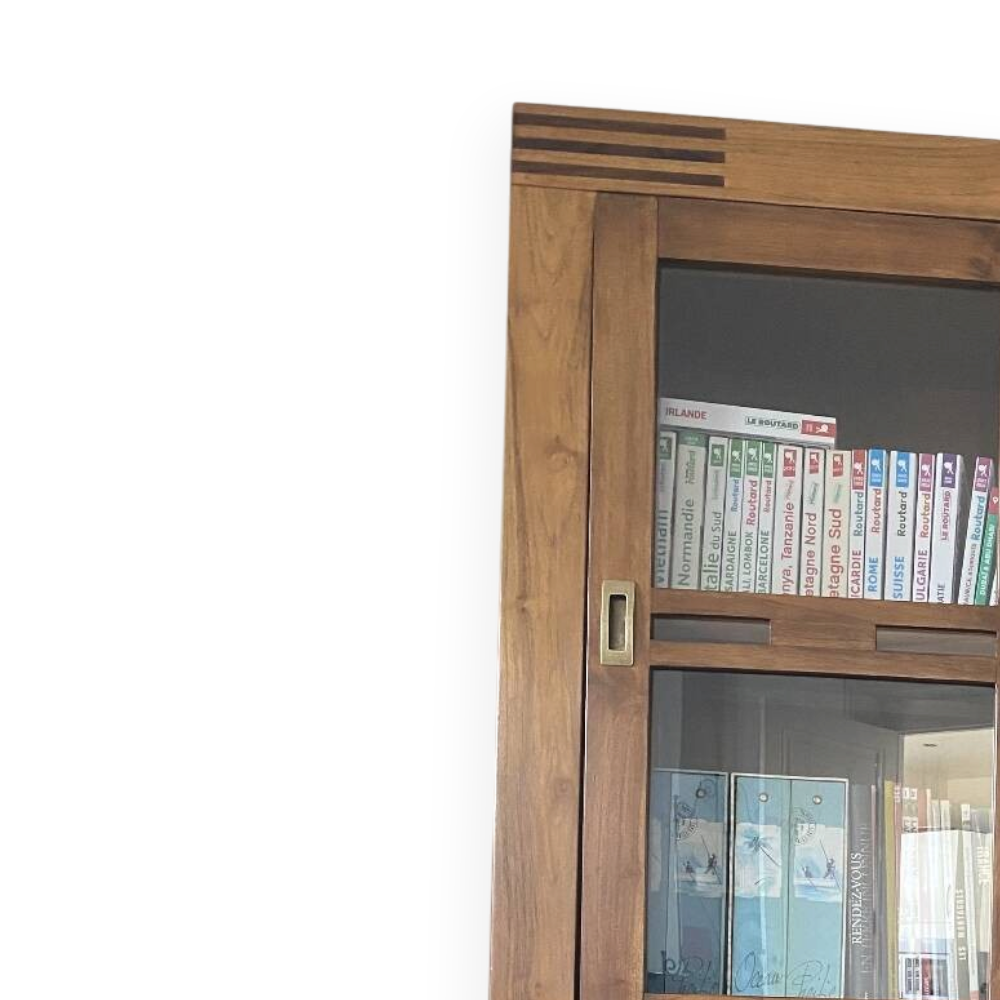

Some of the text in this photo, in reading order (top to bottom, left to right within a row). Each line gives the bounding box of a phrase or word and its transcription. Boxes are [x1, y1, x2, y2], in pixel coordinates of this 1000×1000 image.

[665, 407, 707, 420] IRLANDE
[746, 417, 799, 430] LE ROUTARD
[730, 478, 740, 513] Routard
[746, 479, 758, 526] Routard
[853, 491, 864, 537] Routard
[871, 488, 882, 534] Routard
[897, 491, 907, 537] Routard
[920, 493, 931, 538] Routard
[941, 490, 951, 541] LE ROUTARD
[970, 495, 985, 541] Routard
[677, 498, 695, 587] Normandie
[711, 511, 722, 533] Sud
[711, 535, 720, 549] du
[781, 502, 794, 560] Tanzanie
[804, 512, 817, 546] Nord
[828, 508, 842, 540] Sud
[703, 553, 719, 592] talie
[743, 531, 754, 576] LOMBOK
[804, 550, 817, 597] etagne
[828, 544, 843, 598] etagne
[850, 550, 862, 598] ICARDIE
[867, 556, 879, 593] ROME
[915, 549, 928, 601] ULGARIE
[982, 549, 991, 564] ABU
[782, 565, 795, 594] nya,
[892, 556, 905, 600] SUISSE
[937, 583, 945, 603] ATIE
[850, 852, 863, 945] RENDEZ-VOUS
